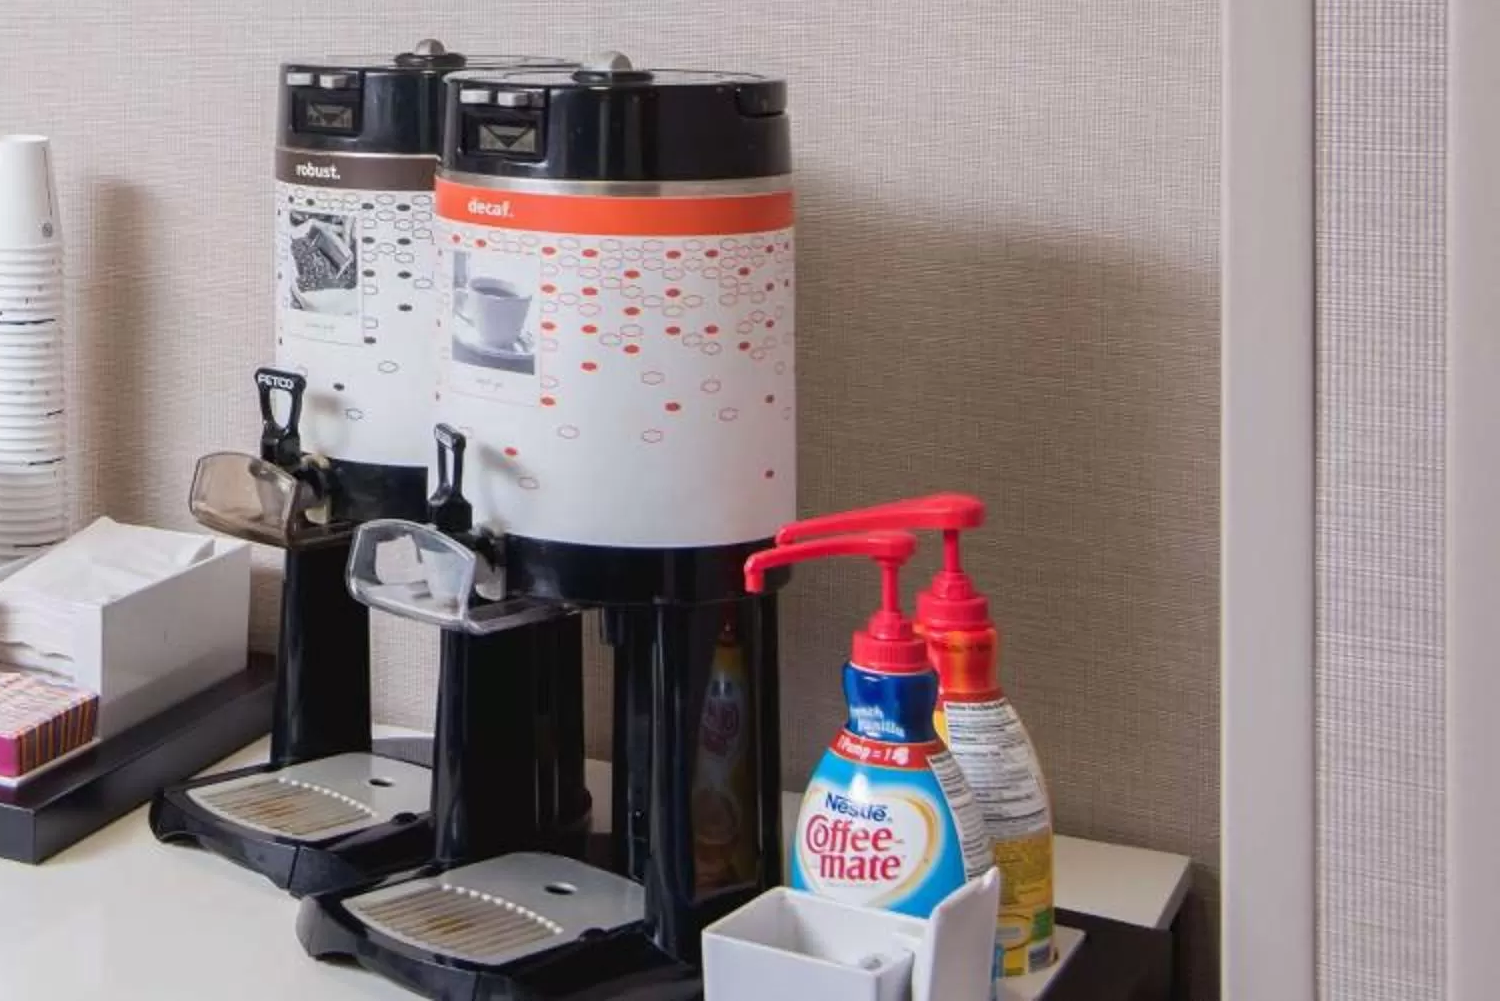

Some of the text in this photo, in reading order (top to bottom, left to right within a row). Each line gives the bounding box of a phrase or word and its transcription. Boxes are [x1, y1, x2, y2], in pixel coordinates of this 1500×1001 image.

[295, 162, 341, 180] robust.
[467, 198, 515, 218] decaf.
[257, 373, 294, 390] FETCO
[820, 854, 901, 882] mate
